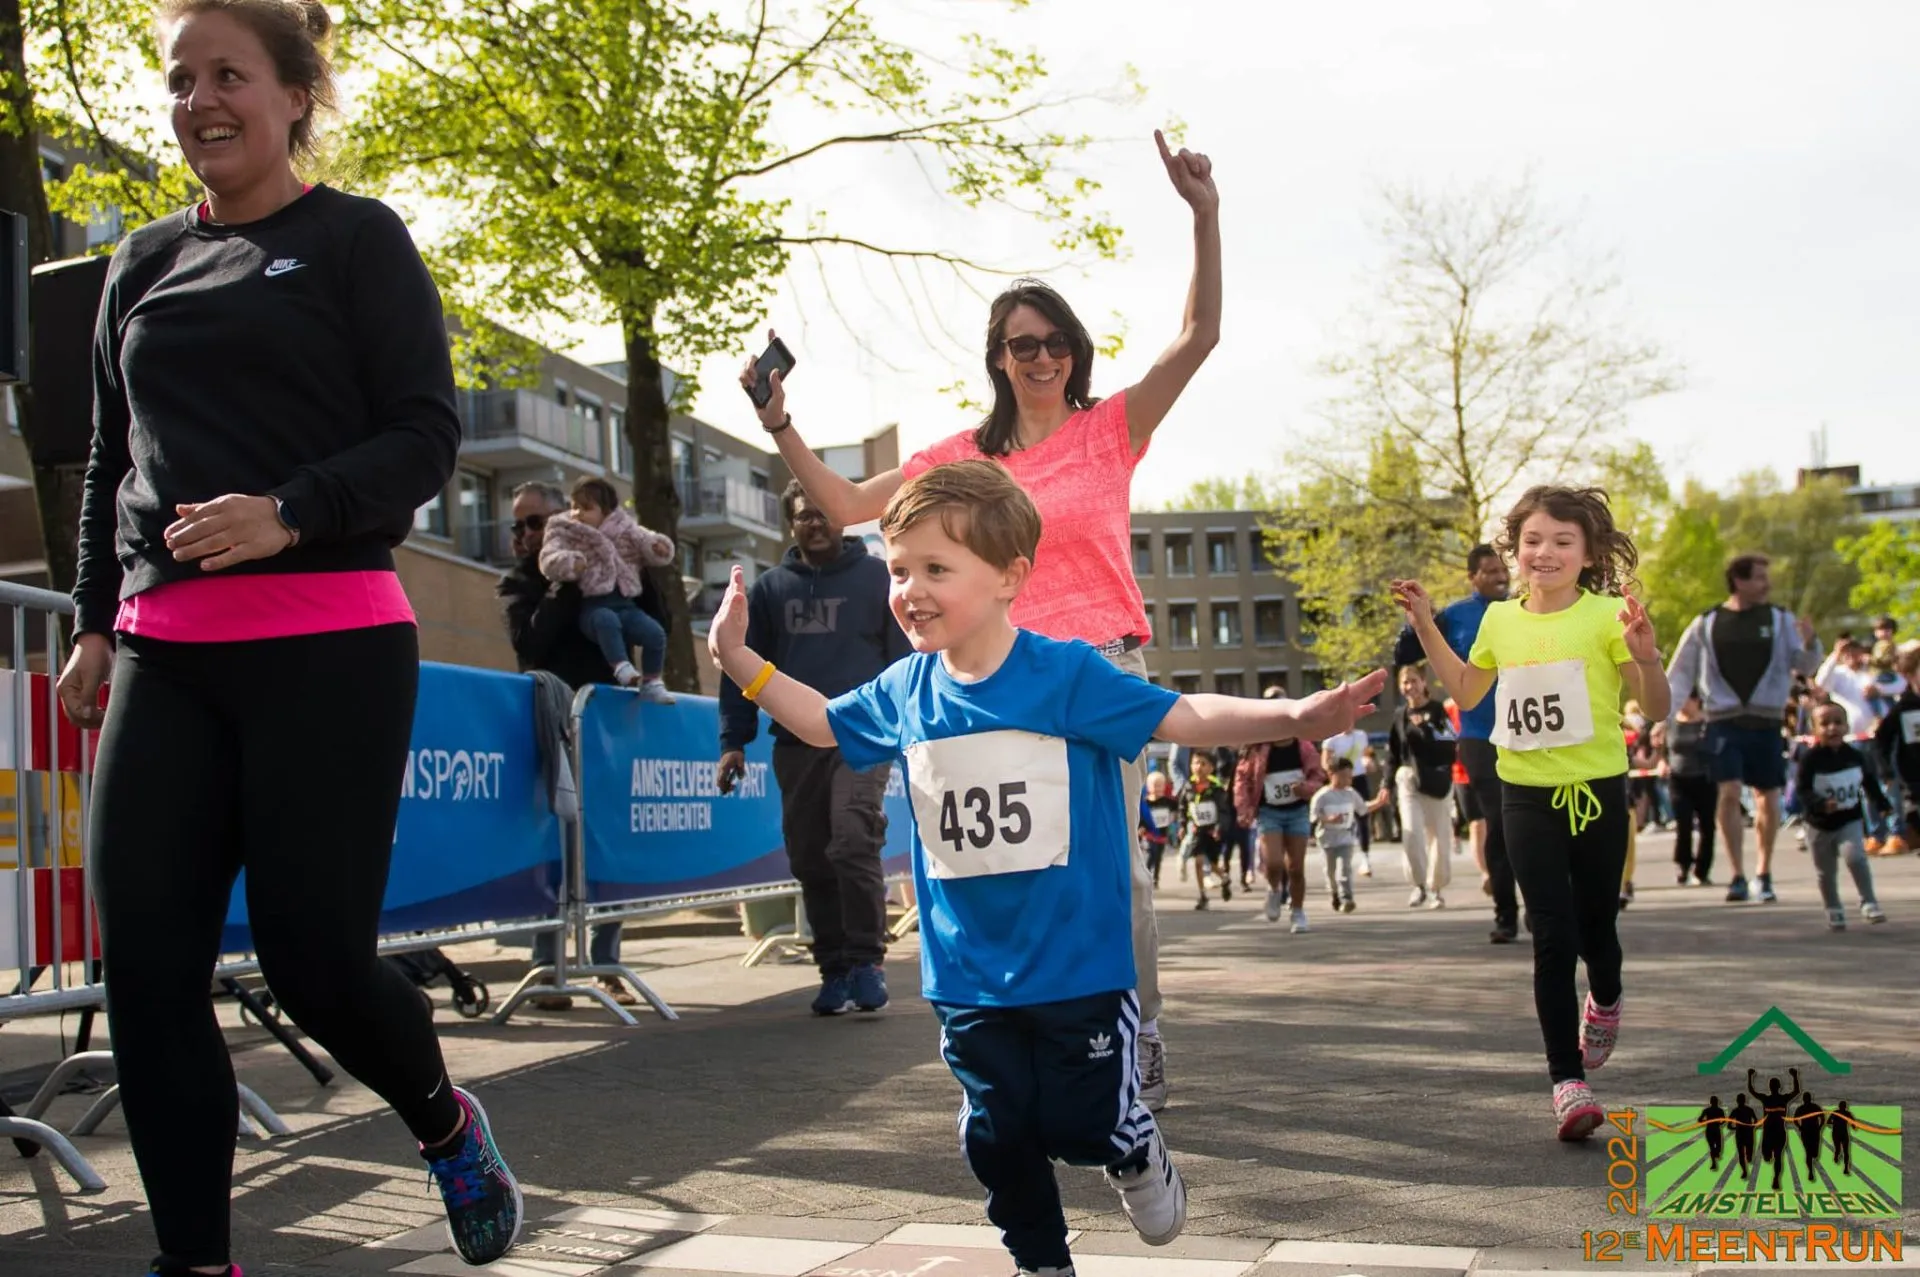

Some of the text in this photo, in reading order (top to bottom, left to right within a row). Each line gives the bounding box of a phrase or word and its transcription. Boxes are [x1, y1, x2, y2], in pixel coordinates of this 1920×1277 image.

[271, 258, 298, 270] NIKE
[784, 598, 841, 634] CAT
[1507, 693, 1565, 736] 465
[630, 758, 768, 799] AMSTELVEENORT
[630, 802, 712, 832] EVENEMENTEN
[940, 781, 1032, 852] 435
[529, 1228, 655, 1244] START
